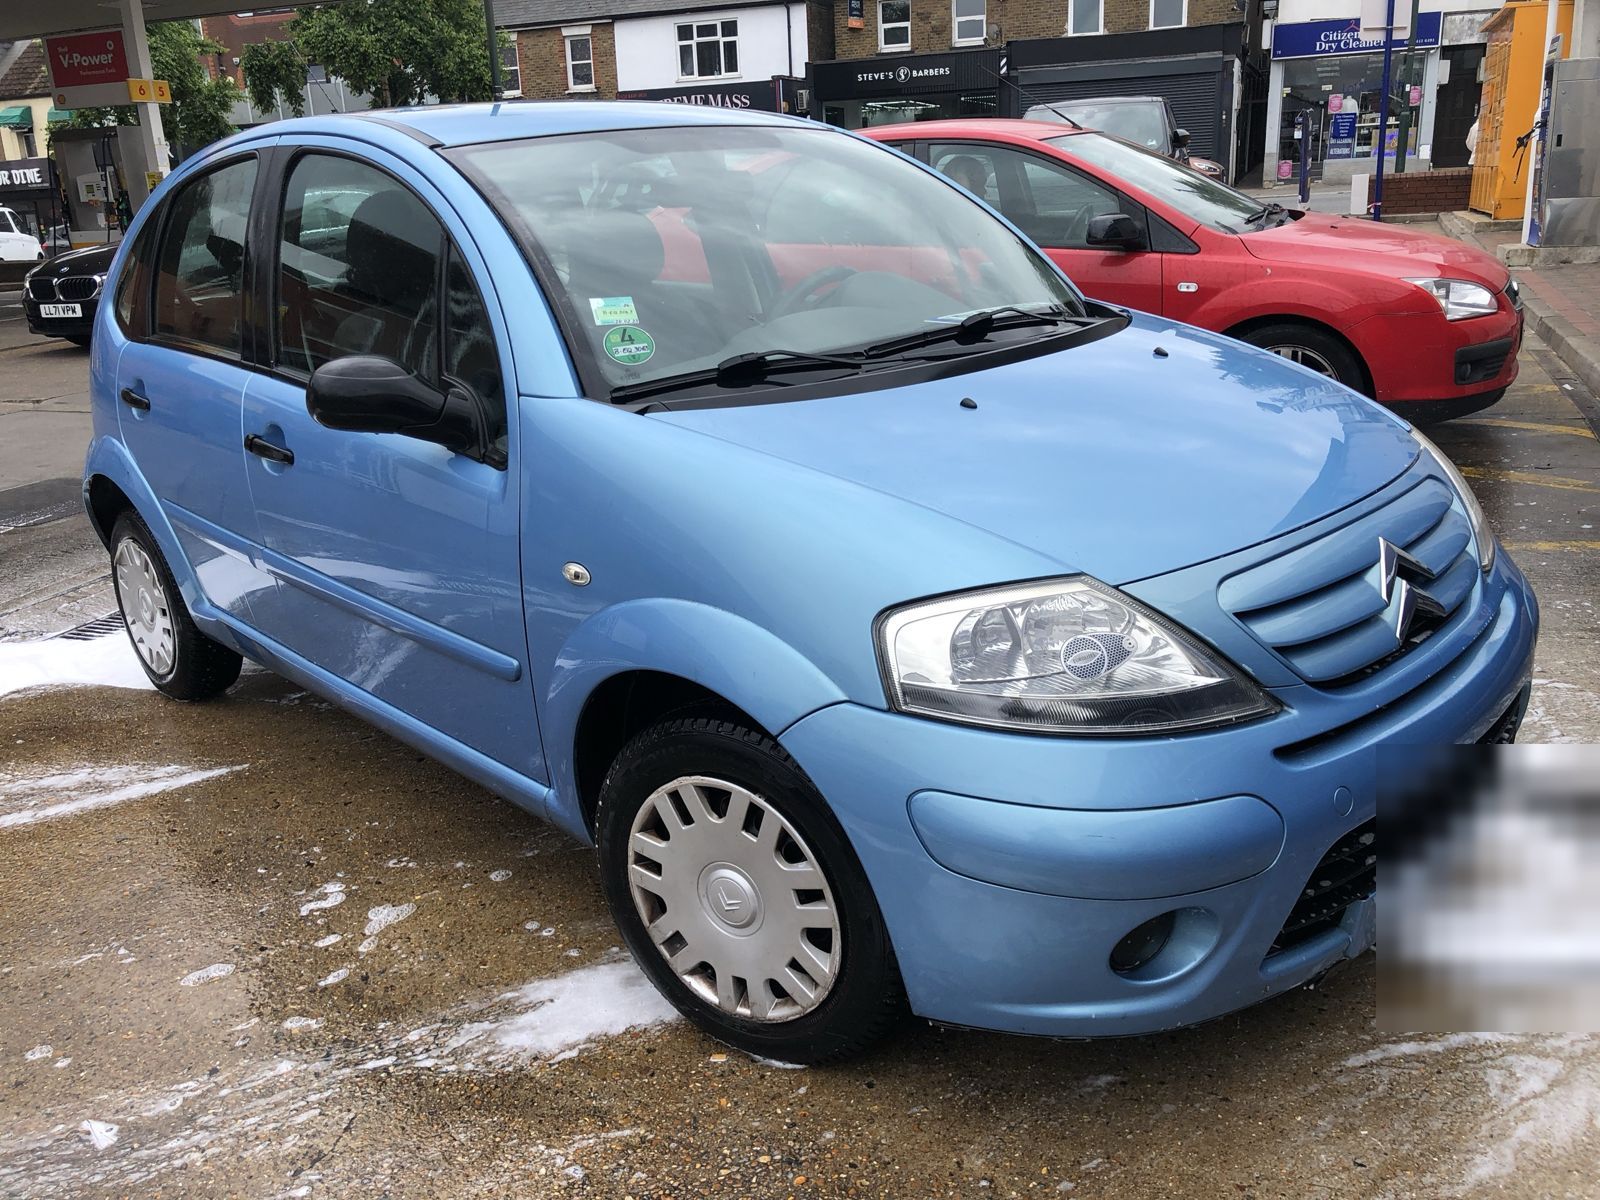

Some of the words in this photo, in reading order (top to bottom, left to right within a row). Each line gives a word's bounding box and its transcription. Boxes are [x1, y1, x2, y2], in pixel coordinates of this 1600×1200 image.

[1315, 41, 1338, 52] Dry
[59, 52, 113, 68] V-Power
[857, 71, 894, 82] STEVE'S
[912, 67, 950, 78] BARBERS
[138, 85, 146, 96] 6
[158, 86, 165, 97] 5
[708, 93, 750, 109] MASS
[11, 167, 42, 185] DINE
[620, 328, 635, 344] 4
